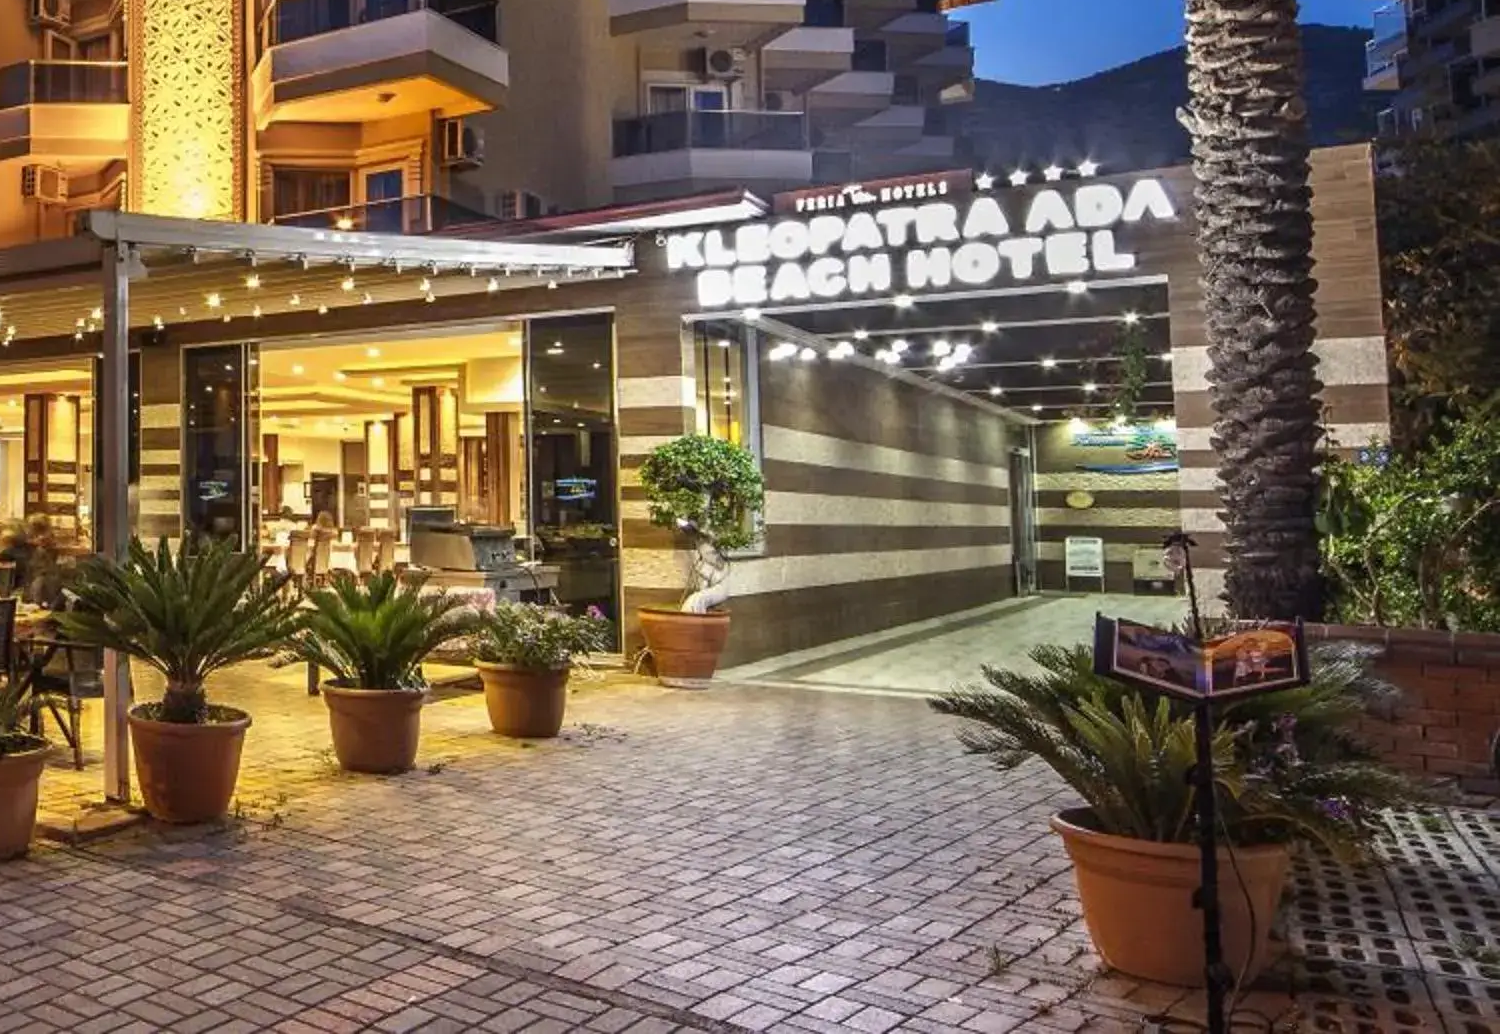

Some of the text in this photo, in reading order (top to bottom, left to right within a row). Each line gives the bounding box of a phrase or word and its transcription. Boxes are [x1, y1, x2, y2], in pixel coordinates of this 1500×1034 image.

[667, 179, 1175, 270] KLEOPATRA ADA
[880, 180, 948, 202] HOTELS
[698, 229, 1136, 306] BEACH HOTEL
